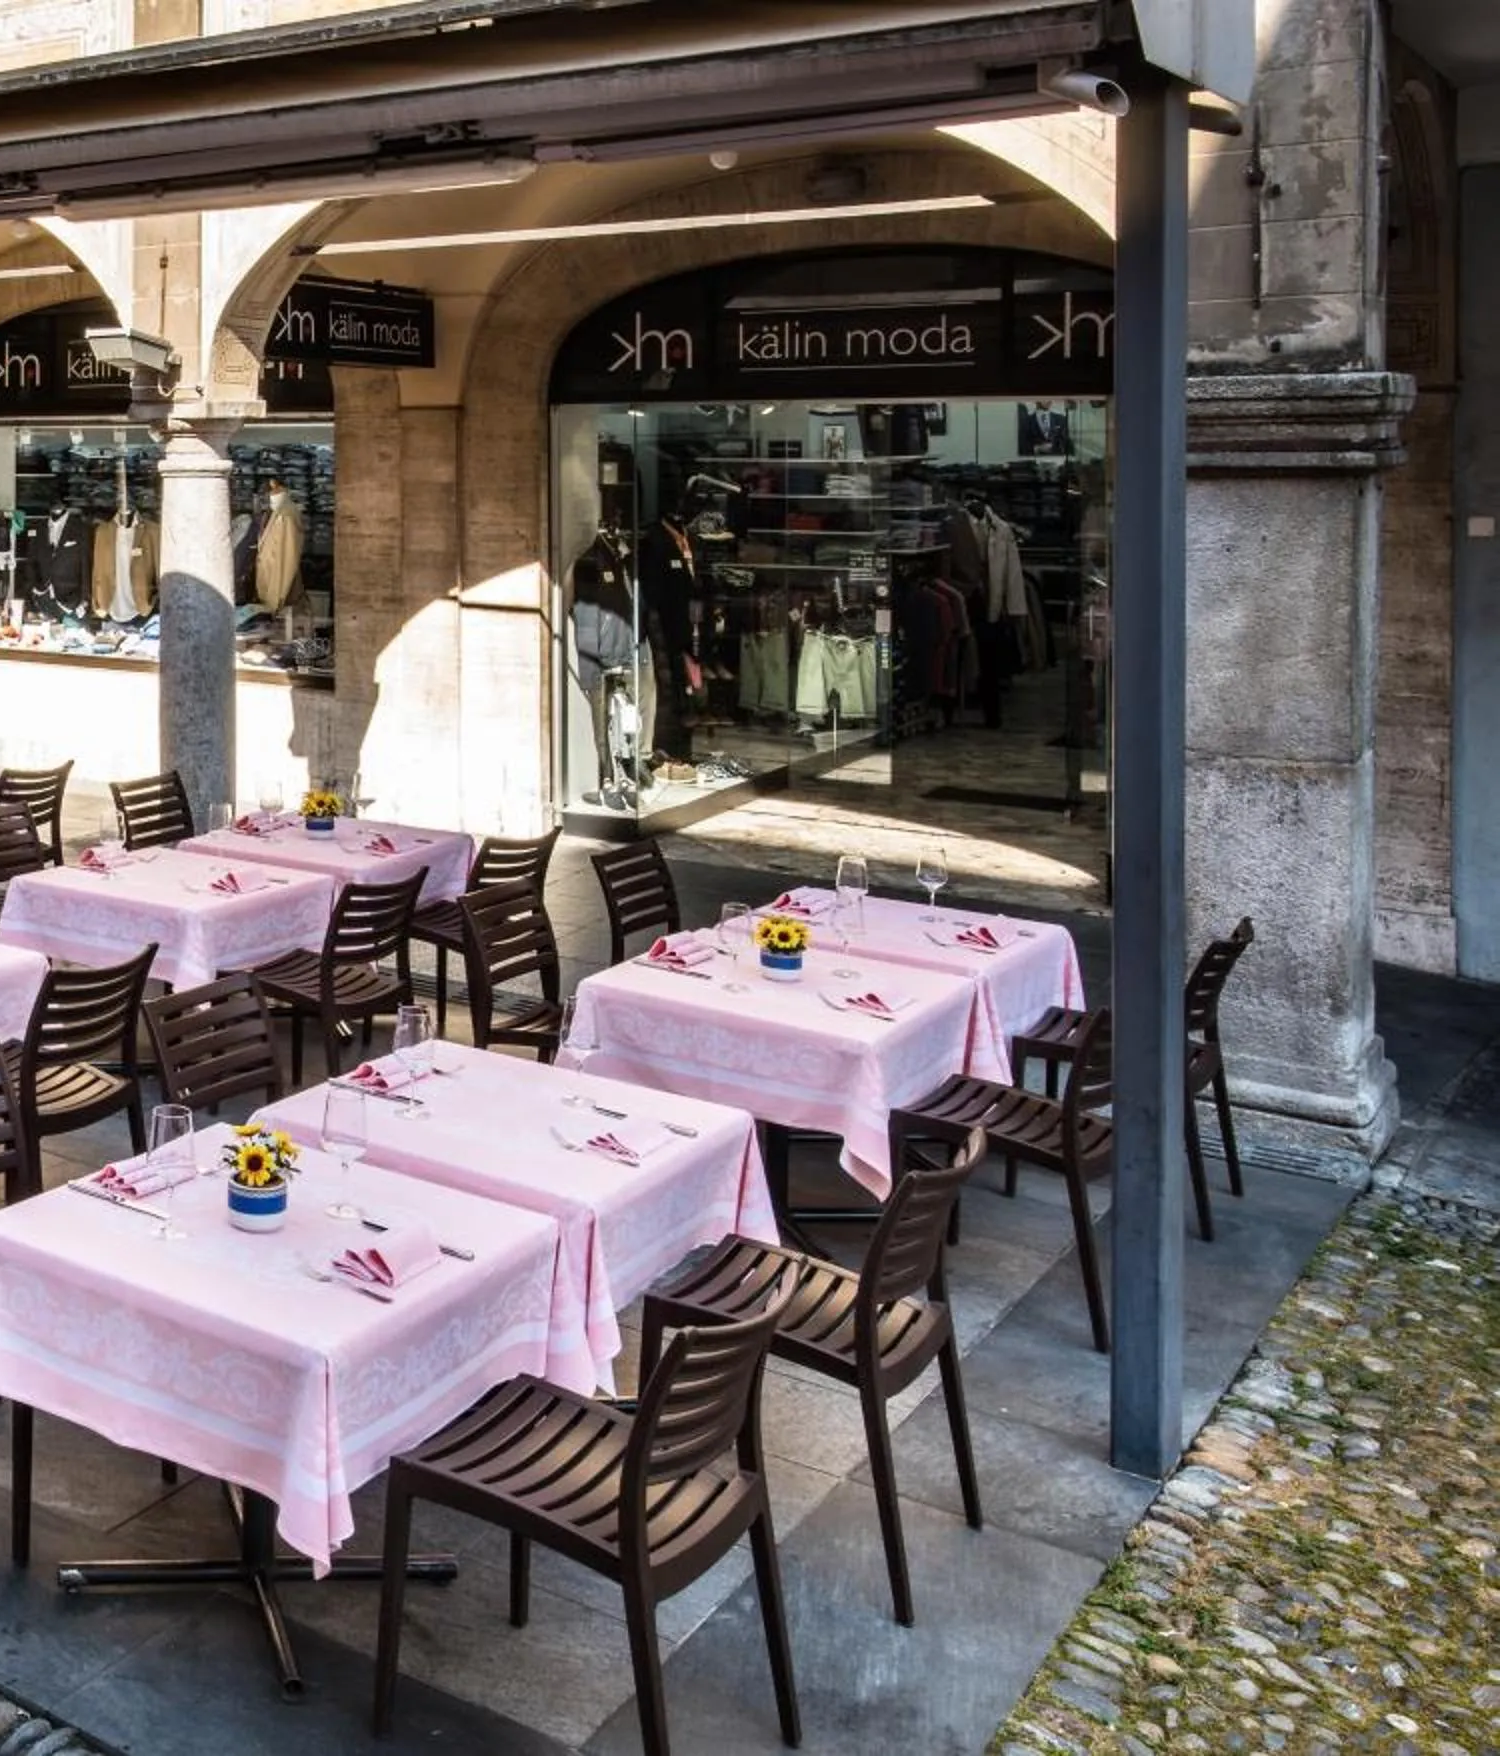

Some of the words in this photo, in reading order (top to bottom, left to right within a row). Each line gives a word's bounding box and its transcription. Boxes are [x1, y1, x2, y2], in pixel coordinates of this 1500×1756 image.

[328, 309, 368, 343] kälin
[372, 318, 421, 347] moda
[738, 320, 828, 360] kälin
[846, 312, 977, 357] moda
